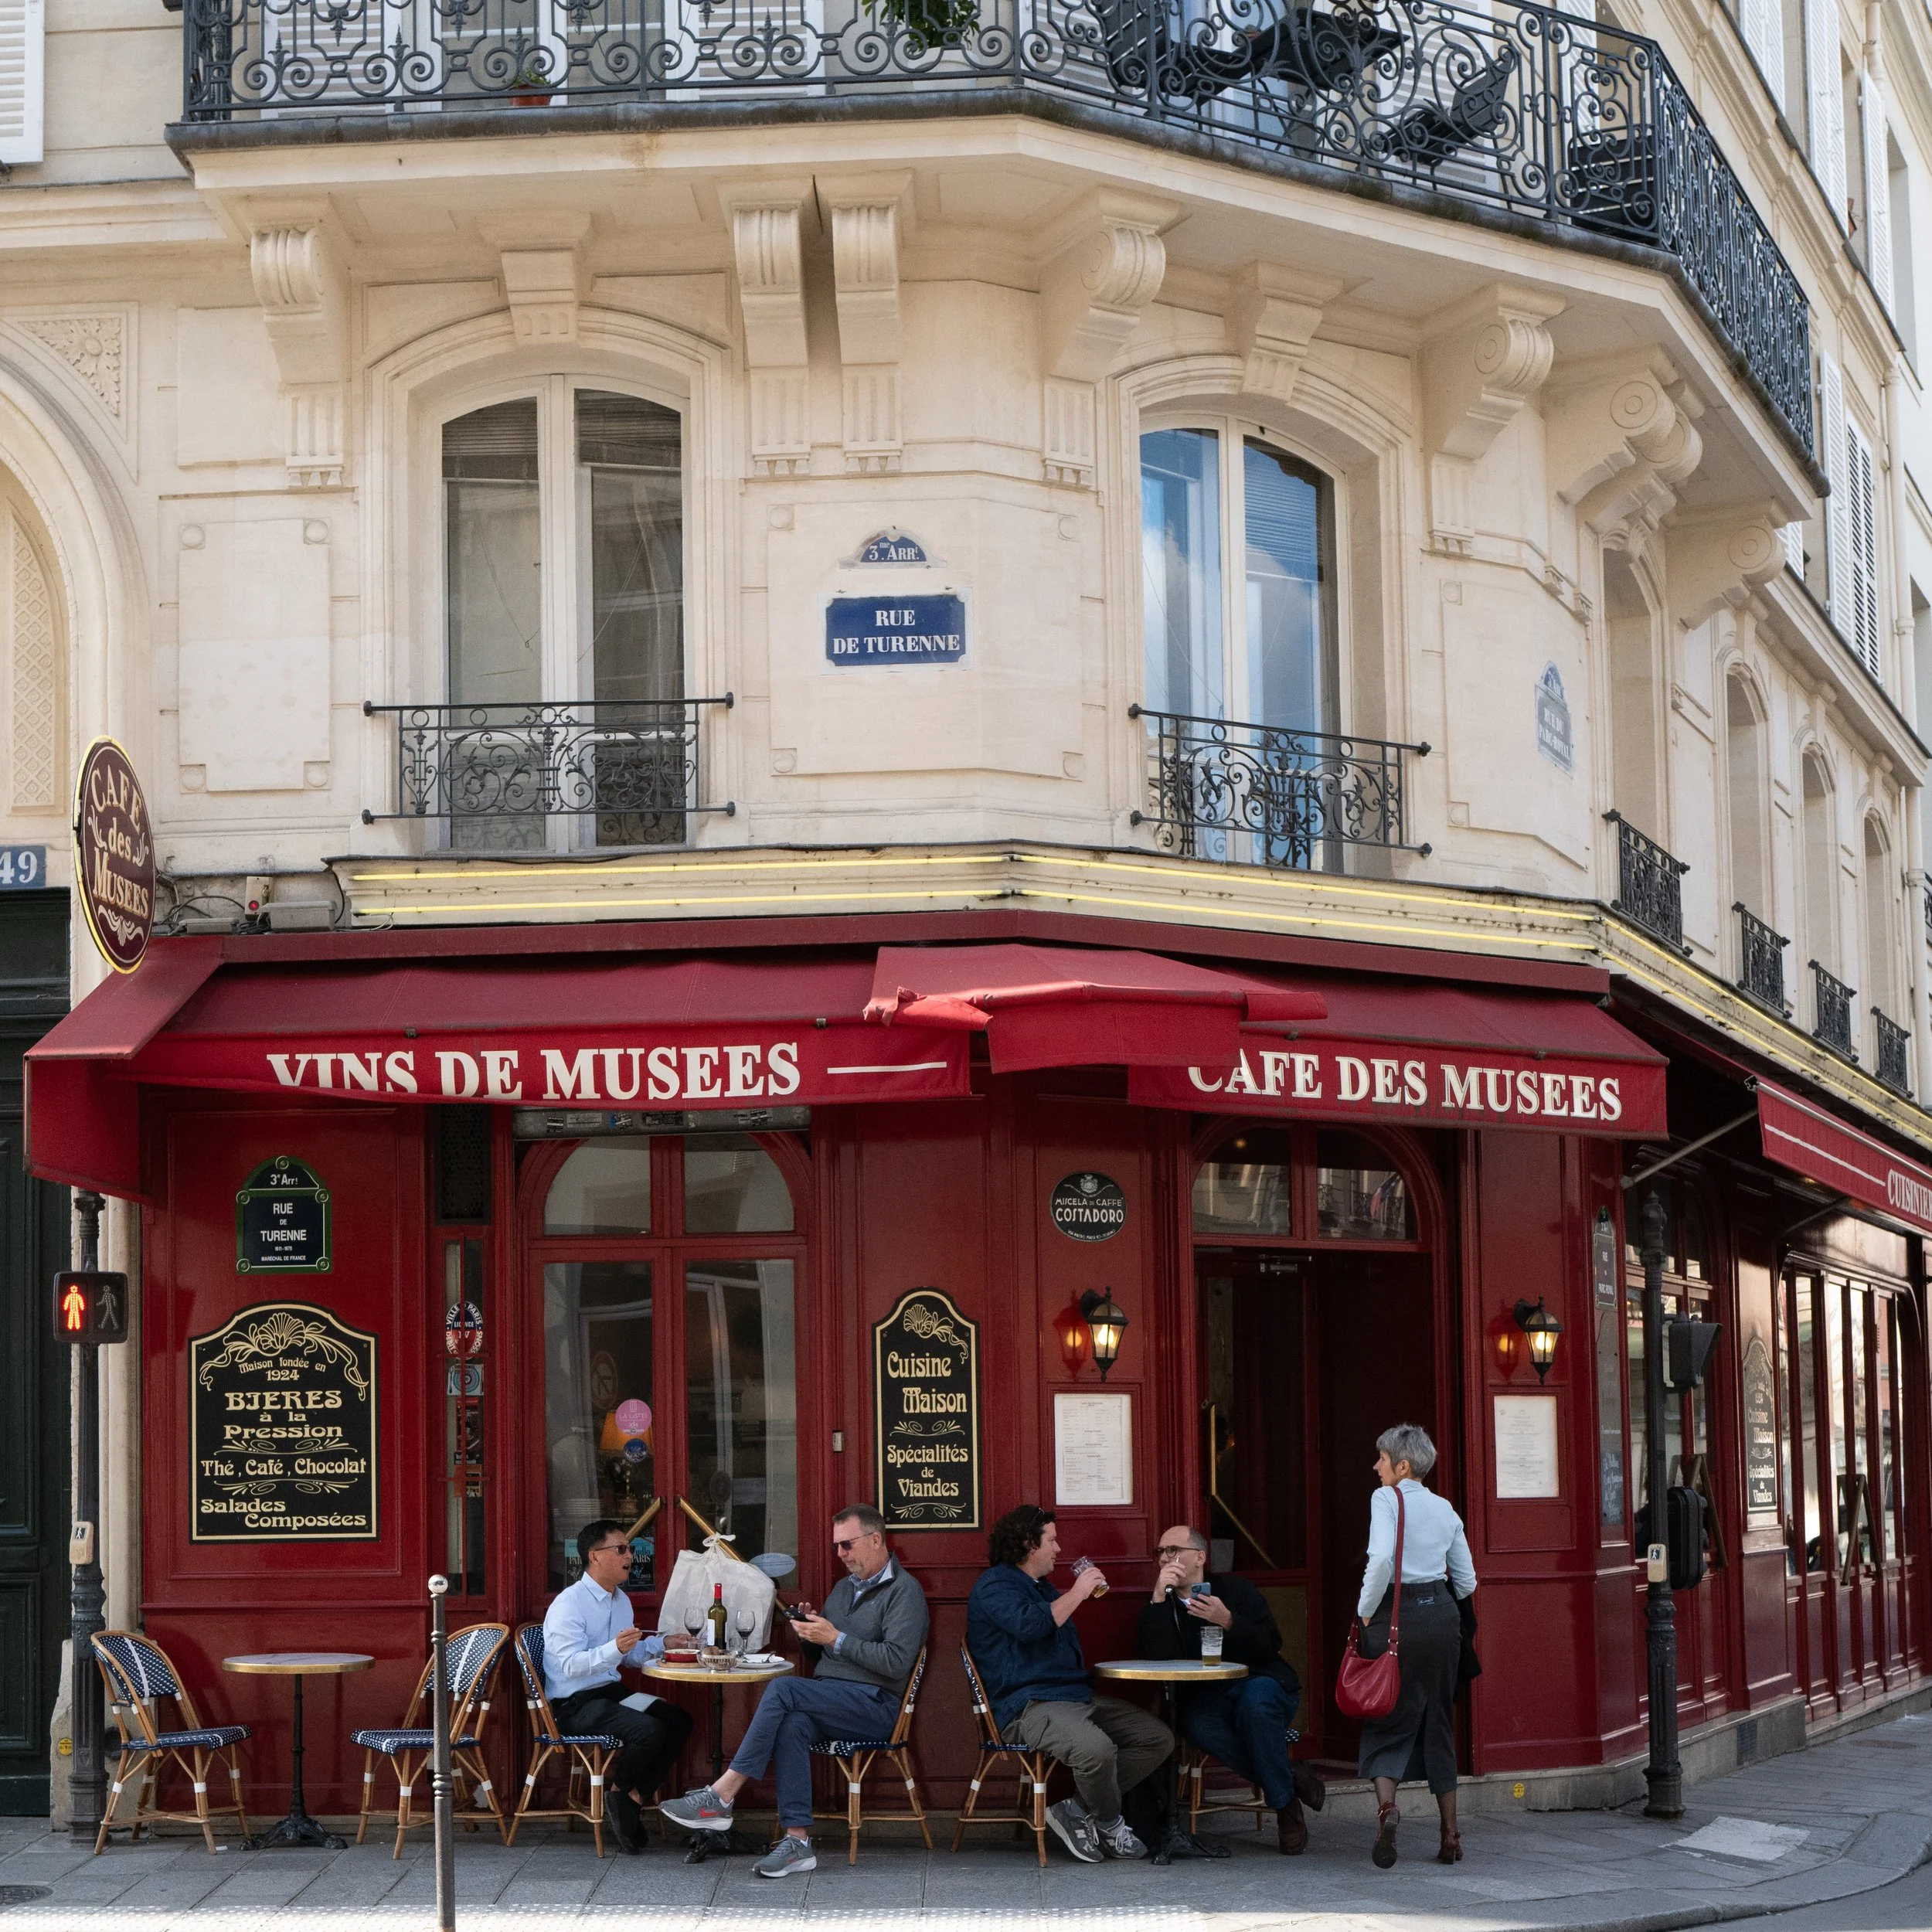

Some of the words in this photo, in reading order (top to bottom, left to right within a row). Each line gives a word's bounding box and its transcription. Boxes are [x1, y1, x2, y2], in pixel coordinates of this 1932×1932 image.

[875, 610, 915, 626] RUE
[833, 638, 859, 655] DE
[864, 634, 960, 653] TURENNE
[91, 764, 142, 835] CAFE
[108, 817, 131, 862] des
[93, 846, 148, 920] MUSEES
[267, 1050, 418, 1094] VINS
[435, 1050, 522, 1100] DE
[540, 1042, 801, 1100] MUSEES
[1335, 1056, 1428, 1106] DES
[1440, 1063, 1622, 1121] MUSEES
[273, 1202, 294, 1214] RUE
[1056, 1208, 1124, 1223] COSTADORO
[260, 1230, 308, 1242] TURENNE
[446, 1304, 460, 1325] VILLE
[468, 1304, 482, 1325] PARIS
[238, 1358, 273, 1374] Maison
[279, 1356, 309, 1369] fondée
[315, 1362, 326, 1372] en
[887, 1351, 951, 1379] Cuisine
[265, 1369, 300, 1381] 1924
[903, 1387, 968, 1413] Maison
[260, 1411, 272, 1422] à
[288, 1411, 307, 1422] la
[223, 1423, 343, 1440] Pression
[1753, 1427, 1774, 1444] Maison
[887, 1444, 968, 1468] Spécialités
[294, 1458, 366, 1475] Chocolat
[921, 1466, 934, 1478] de
[897, 1478, 959, 1497] Viandes
[1753, 1488, 1772, 1503] Viandes
[200, 1498, 286, 1514] Salades
[244, 1512, 366, 1530] Composées
[635, 1546, 650, 1555] udlo
